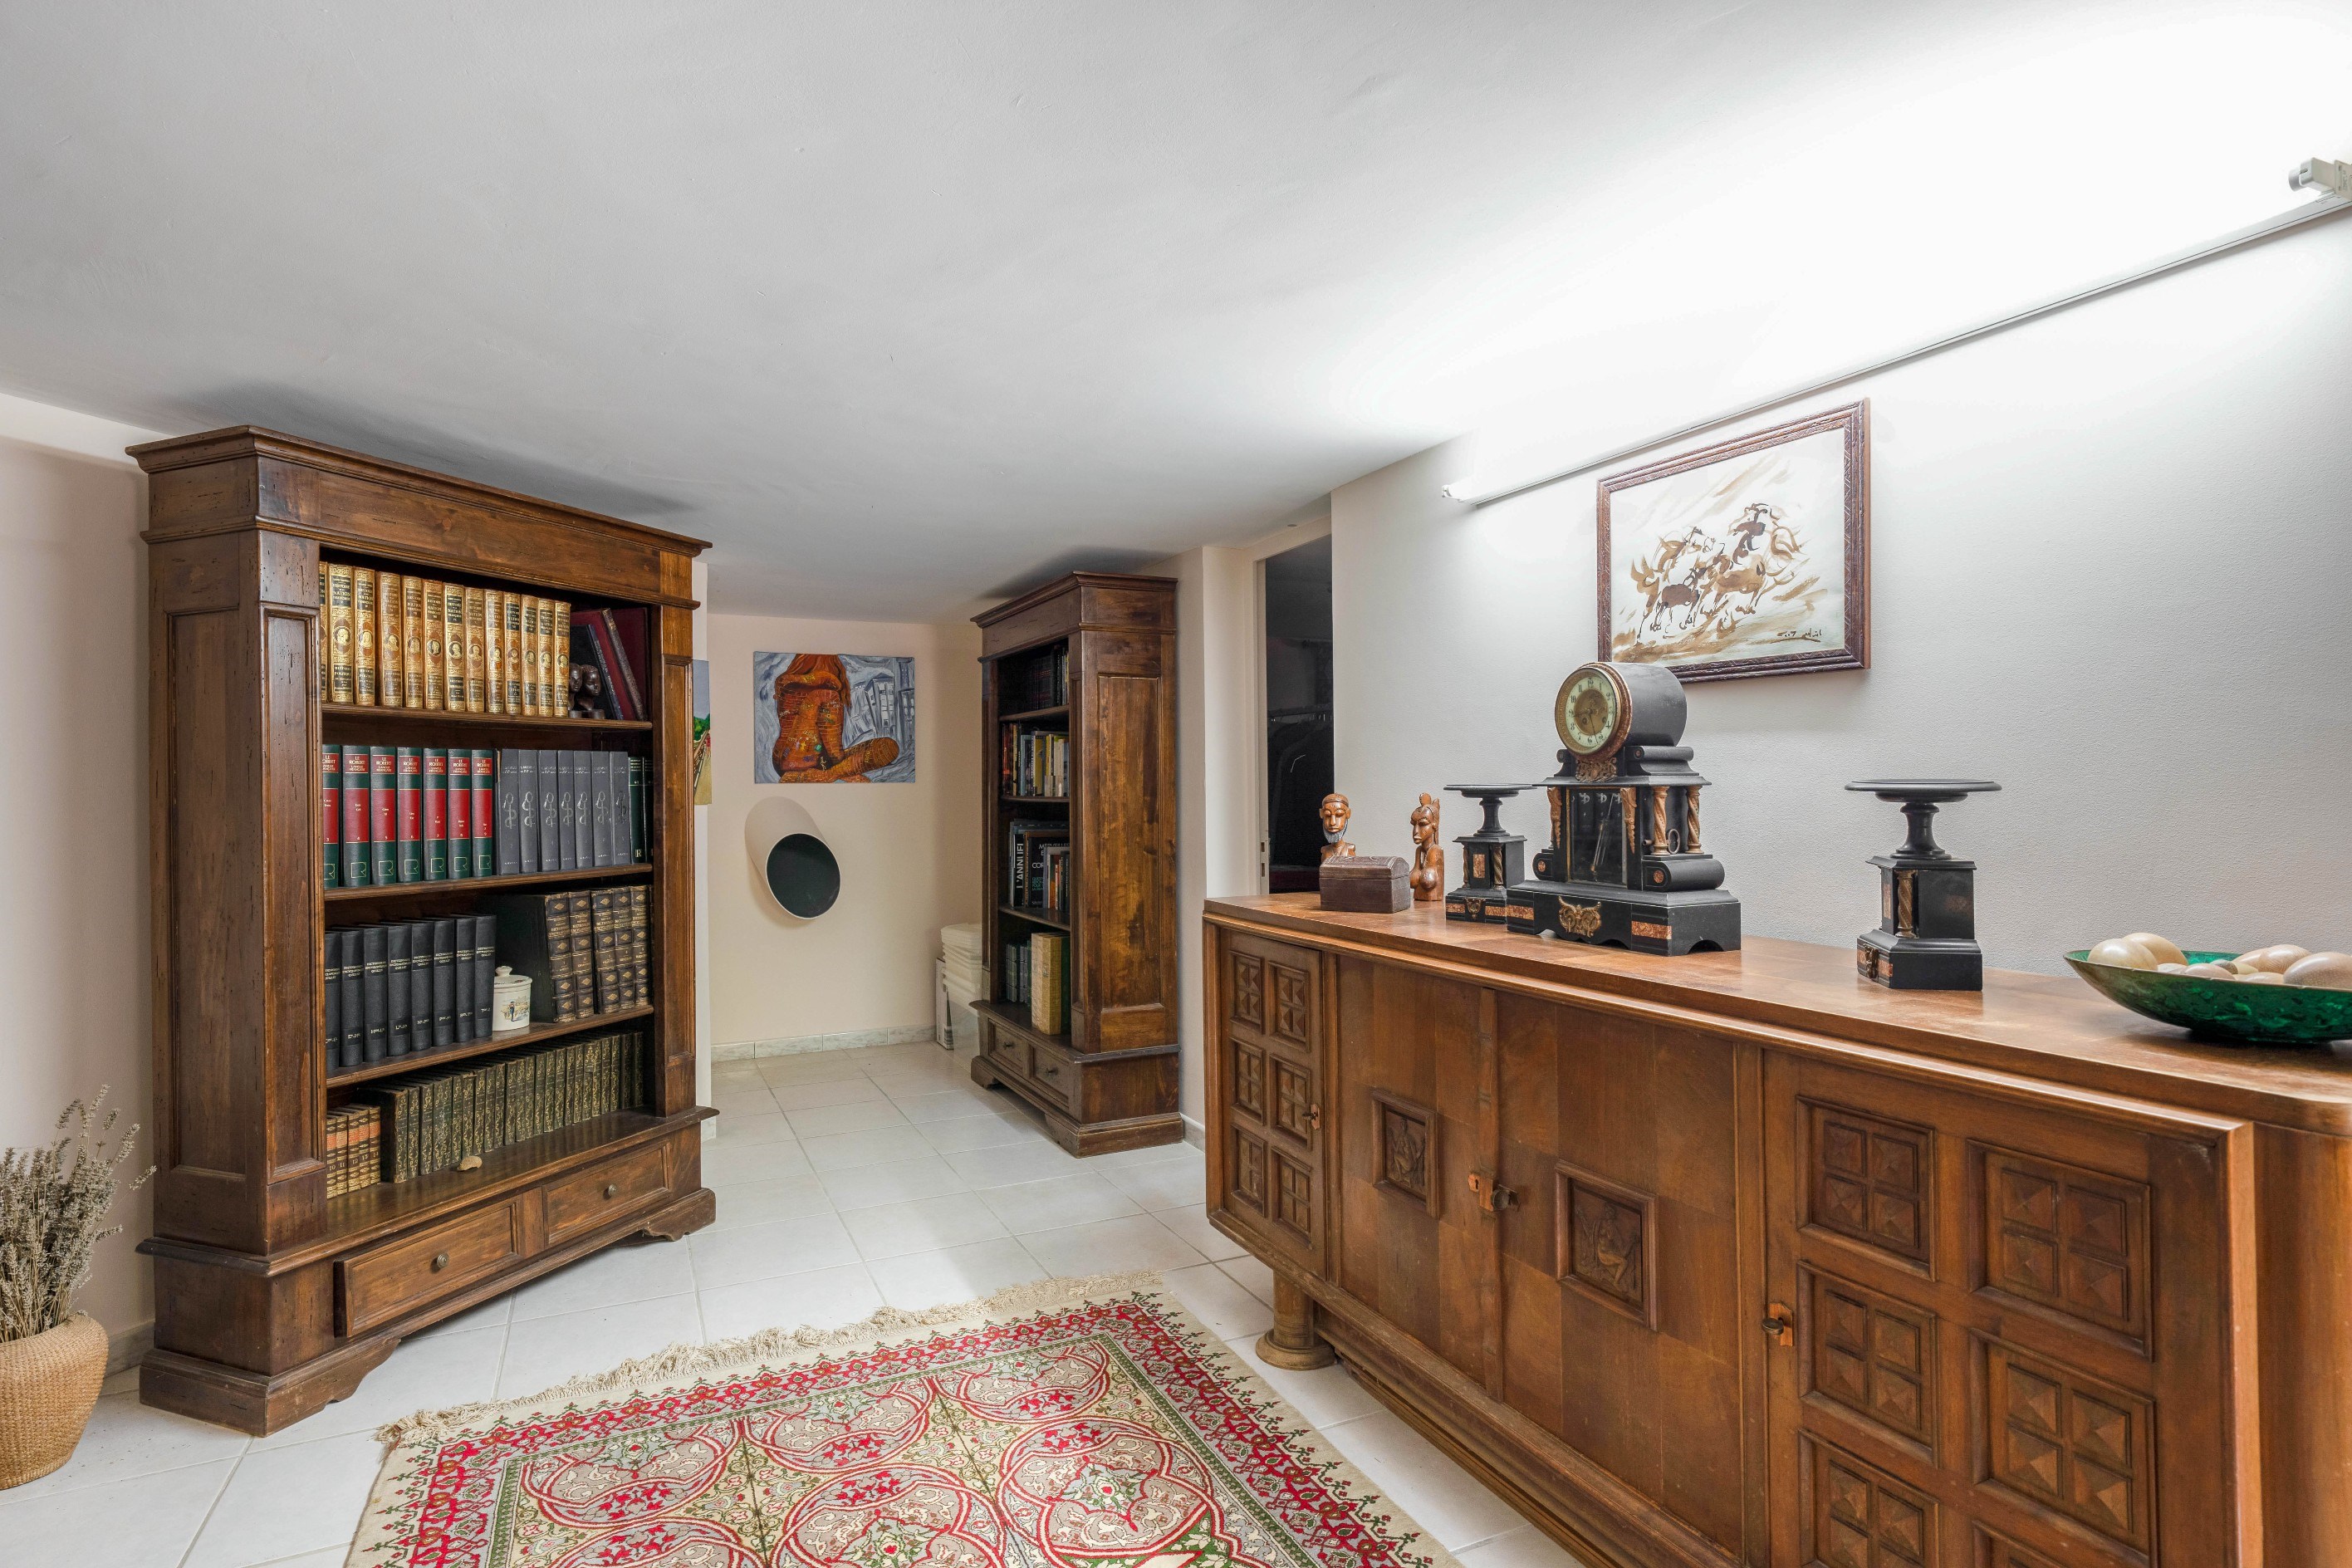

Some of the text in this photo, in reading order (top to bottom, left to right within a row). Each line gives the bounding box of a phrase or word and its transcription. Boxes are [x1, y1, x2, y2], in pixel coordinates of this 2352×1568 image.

[1570, 694, 1576, 703] 10
[1570, 722, 1575, 731] 8
[1605, 721, 1612, 729] 4
[1587, 735, 1593, 744] 6
